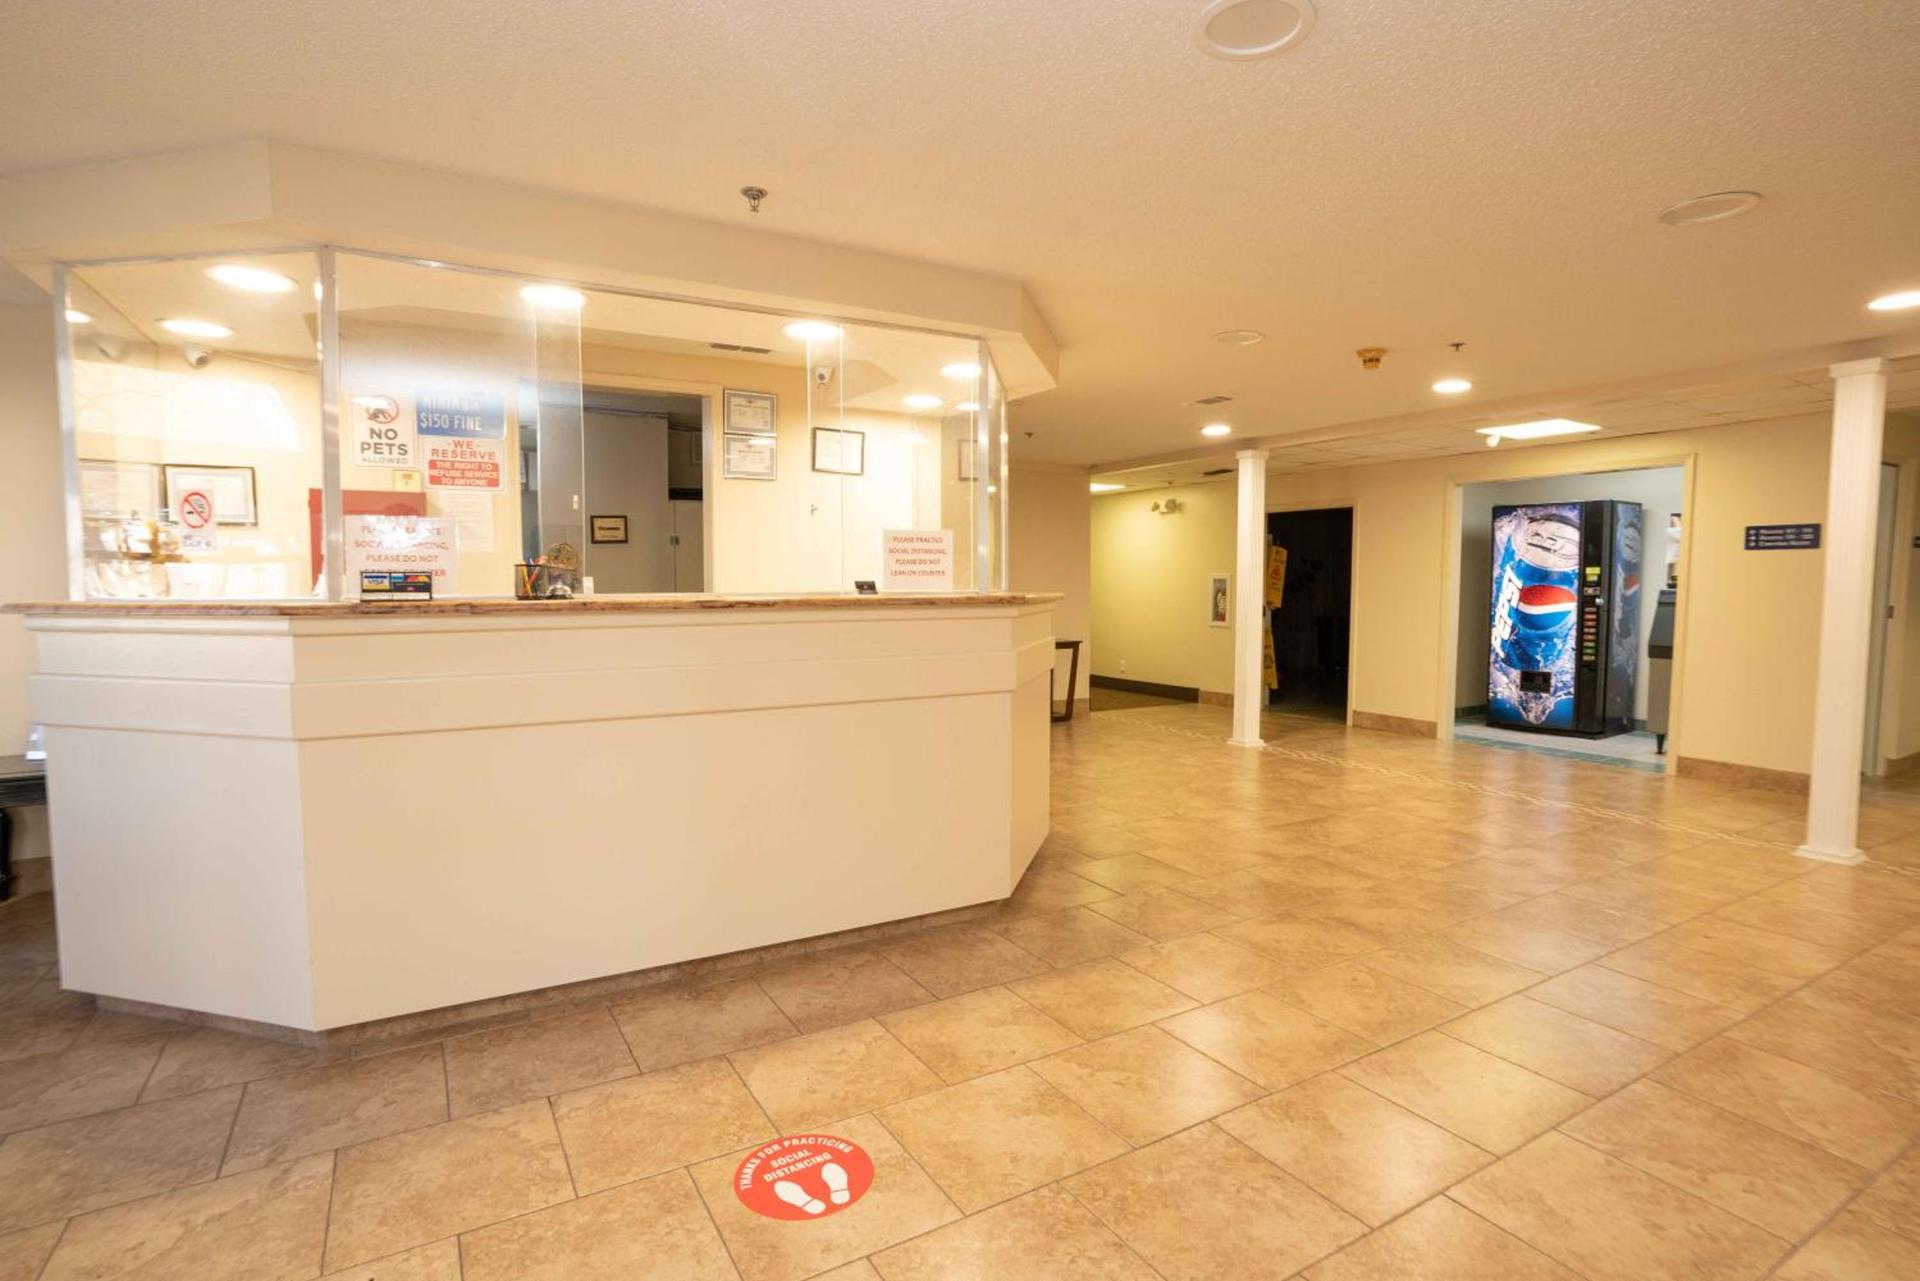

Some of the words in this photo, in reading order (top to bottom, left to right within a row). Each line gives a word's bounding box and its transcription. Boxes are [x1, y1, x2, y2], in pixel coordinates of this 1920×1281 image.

[420, 411, 449, 429] $150
[454, 415, 482, 431] FINE
[370, 428, 398, 441] NO
[361, 441, 408, 456] PETS
[452, 439, 474, 450] WE
[362, 457, 409, 465] ALLOWED
[431, 448, 497, 460] RESERVE
[366, 554, 400, 563] PLEASE
[403, 554, 417, 563] DO
[419, 554, 439, 563] NOT
[740, 1157, 761, 1190] THANKS
[758, 1144, 782, 1159] FOR
[784, 1137, 854, 1154] PRACTICING
[770, 1149, 813, 1168] SOCIAL
[763, 1152, 833, 1182] DISTANCING
